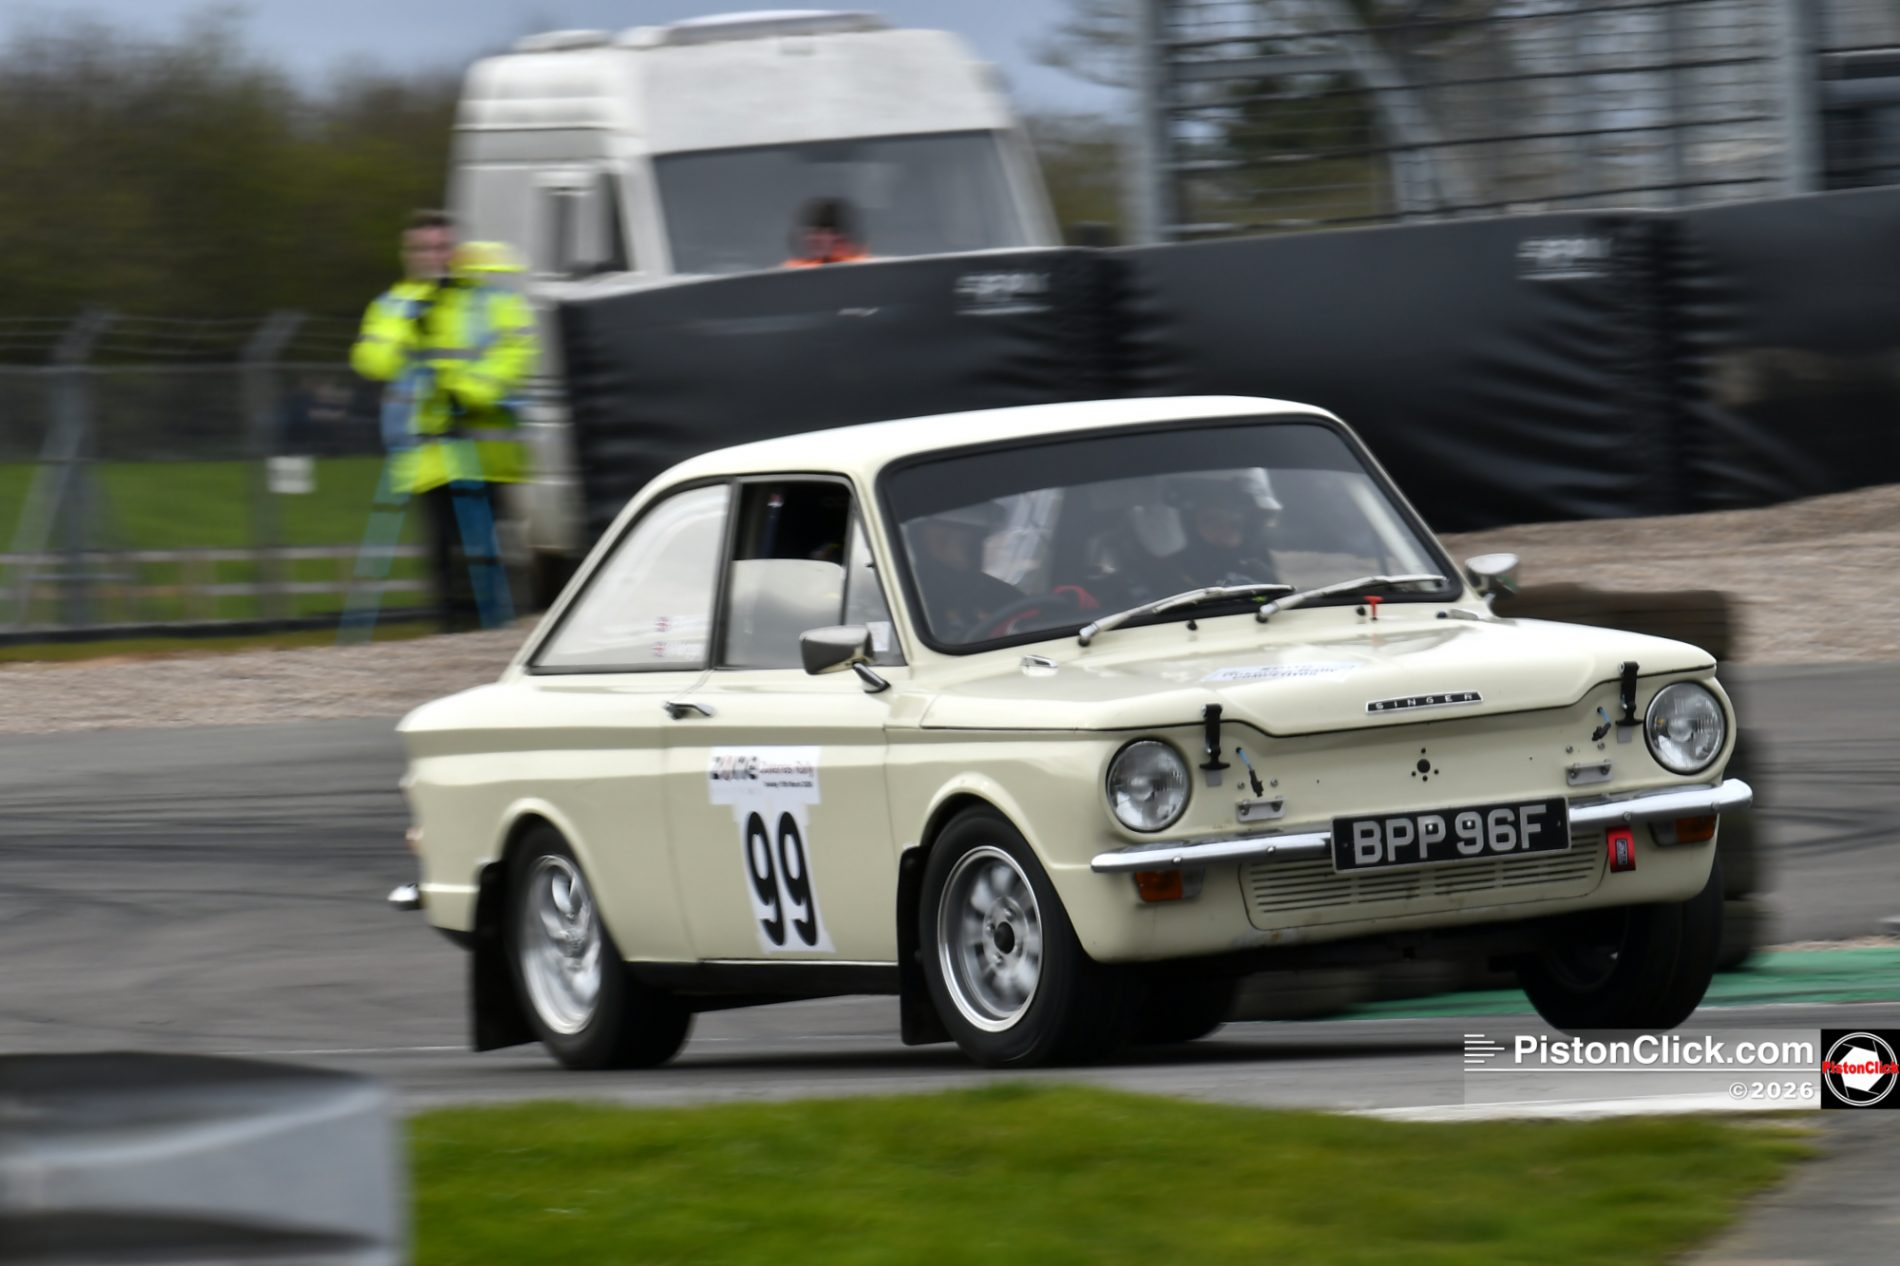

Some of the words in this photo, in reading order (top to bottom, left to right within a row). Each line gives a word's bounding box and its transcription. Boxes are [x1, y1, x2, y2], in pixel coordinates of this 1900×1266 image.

[1375, 692, 1472, 710] SINGER
[1352, 814, 1446, 865] BPP
[1455, 804, 1547, 855] 96F
[746, 811, 818, 947] 99
